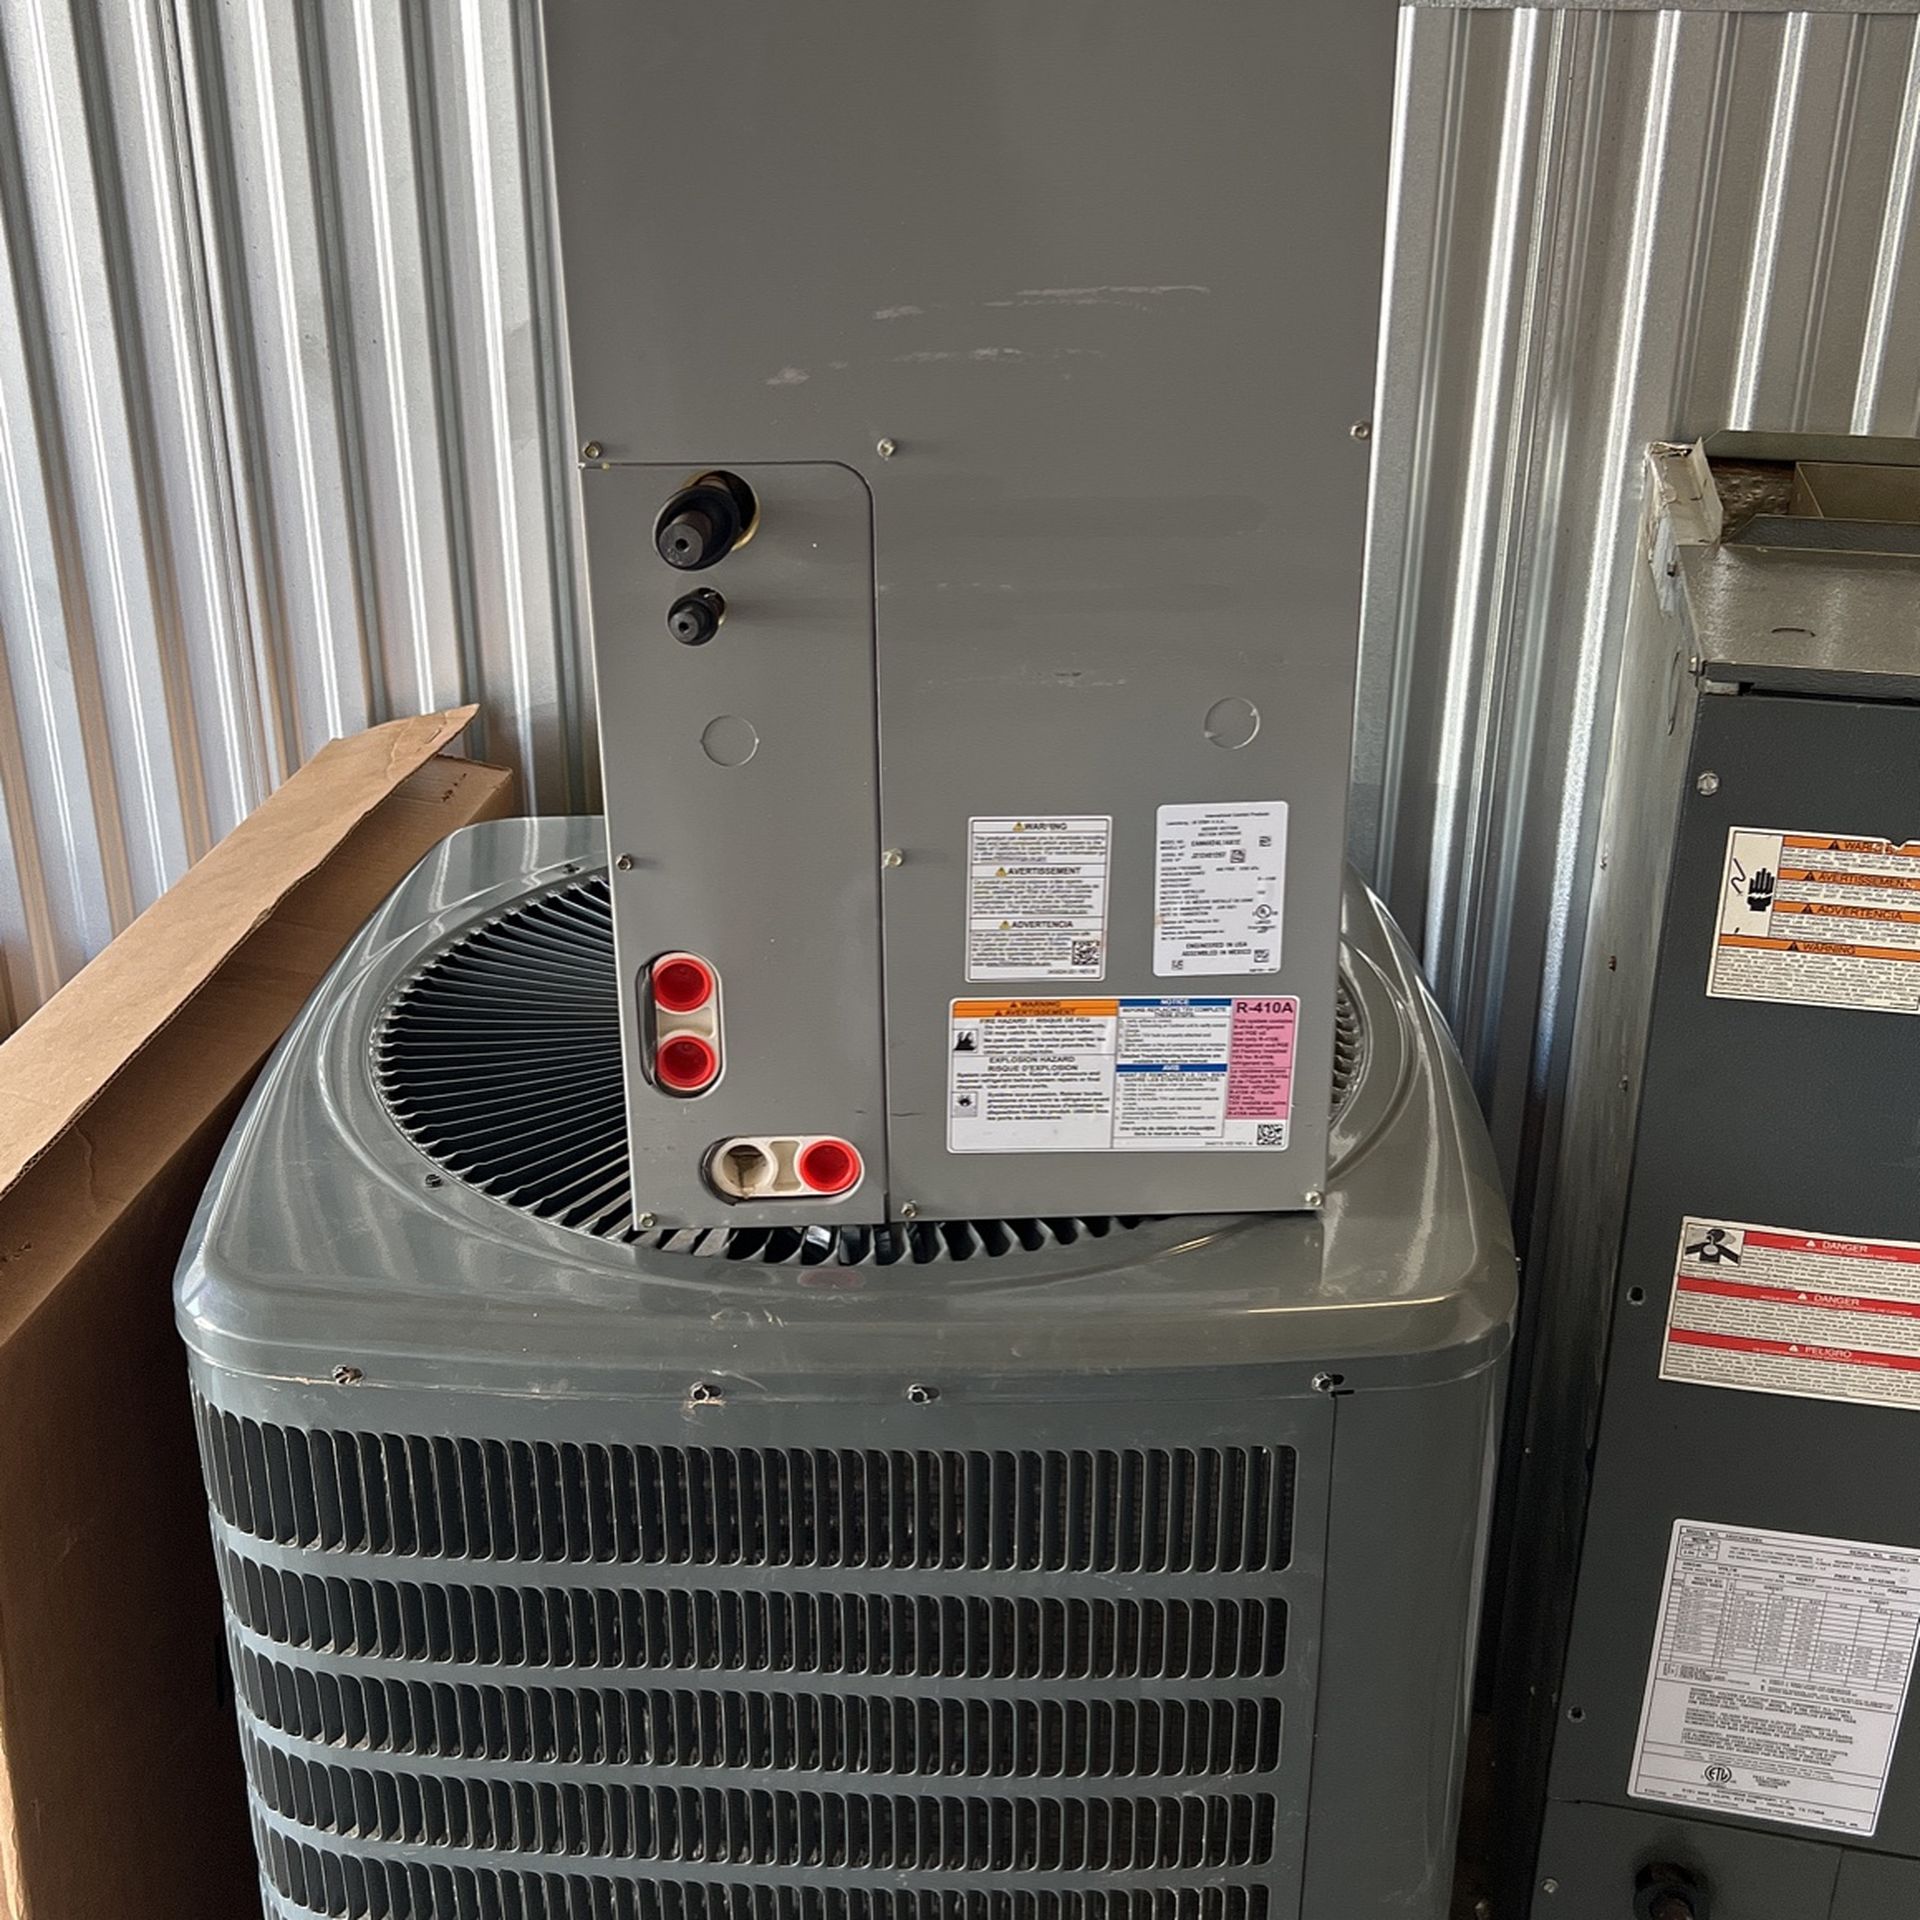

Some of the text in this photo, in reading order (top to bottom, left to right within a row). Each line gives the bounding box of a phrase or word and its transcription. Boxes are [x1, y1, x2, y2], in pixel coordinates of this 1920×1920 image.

[1009, 866, 1081, 876] AVERTISSEMENT
[1817, 904, 1903, 921] ADVERTENCIA
[1012, 920, 1074, 929] ADVERTENCIA
[1186, 942, 1224, 950] ENGINEERED
[1803, 943, 1857, 957] WARNING
[1005, 1008, 1076, 1016] AVERTISSEMENT
[1236, 1001, 1294, 1014] R-410A
[989, 1055, 1076, 1064] EXPLOSION HAZARD
[988, 1064, 1020, 1072] RISQUE
[1821, 1240, 1869, 1254] DANGER
[1813, 1293, 1860, 1307] DANGER
[1804, 1345, 1852, 1359] PELIGRO
